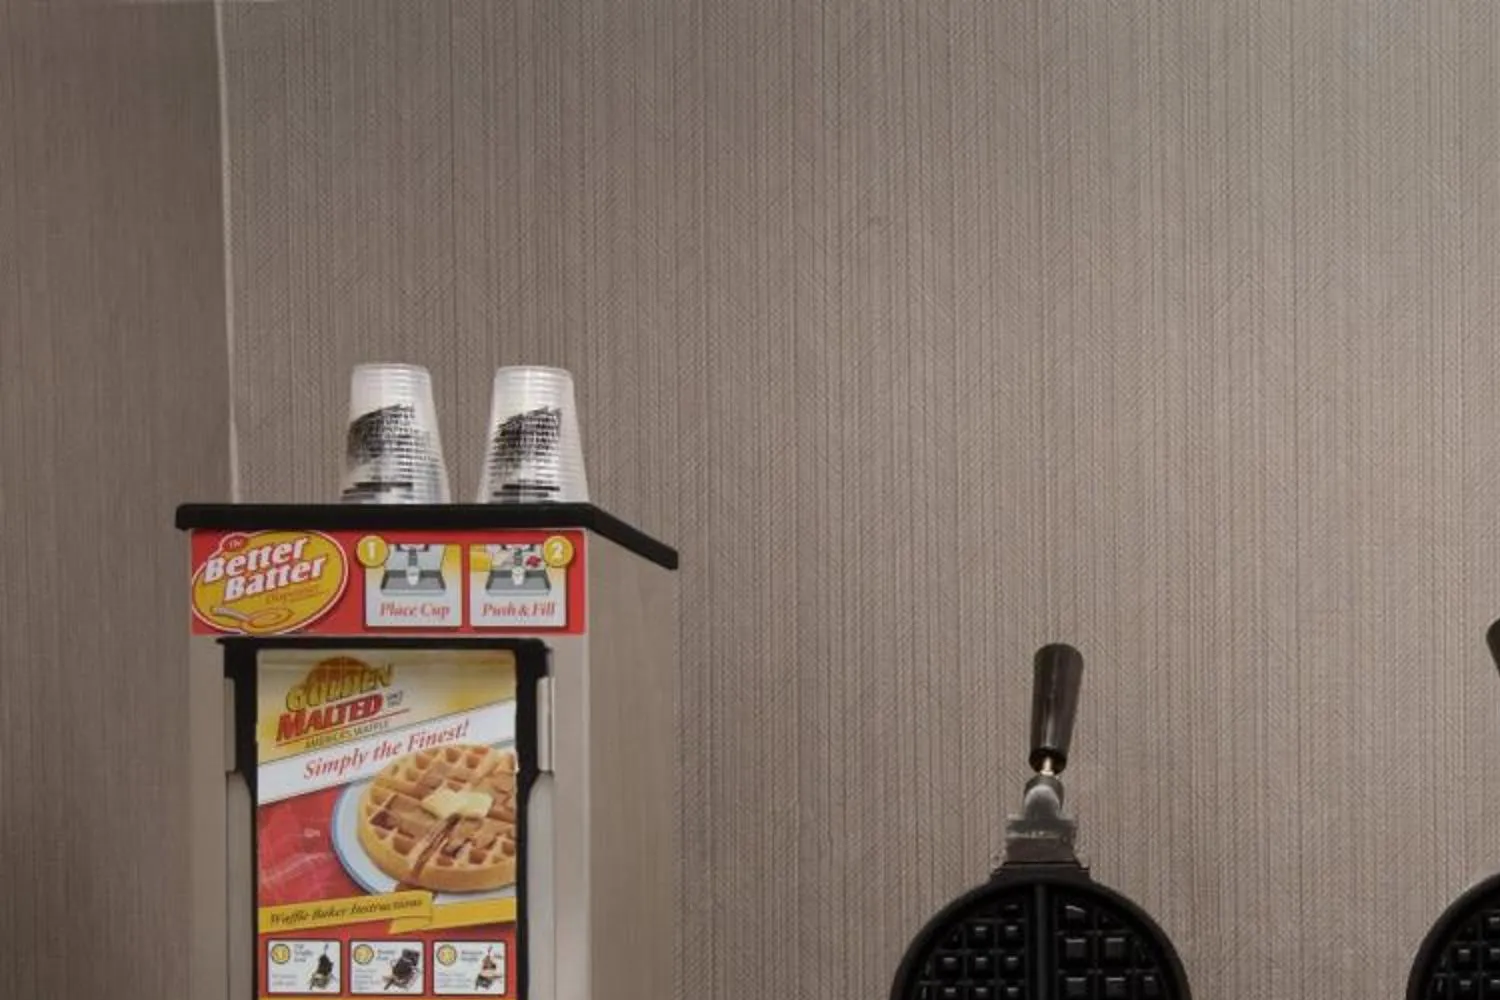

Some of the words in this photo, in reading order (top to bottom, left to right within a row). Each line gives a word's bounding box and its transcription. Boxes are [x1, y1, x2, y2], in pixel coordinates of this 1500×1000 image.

[204, 537, 309, 583] Better
[368, 542, 376, 560] 1
[552, 543, 564, 561] 2
[224, 556, 326, 602] Batter
[380, 602, 416, 618] Place
[420, 602, 450, 619] Cup
[482, 602, 516, 618] Push
[528, 602, 557, 618] Fill
[286, 662, 395, 712] GOLDEN
[275, 692, 385, 743] MALTED
[304, 747, 369, 780] Simply
[372, 740, 404, 763] the
[407, 717, 471, 753] Finest!
[270, 909, 310, 926] Waffle
